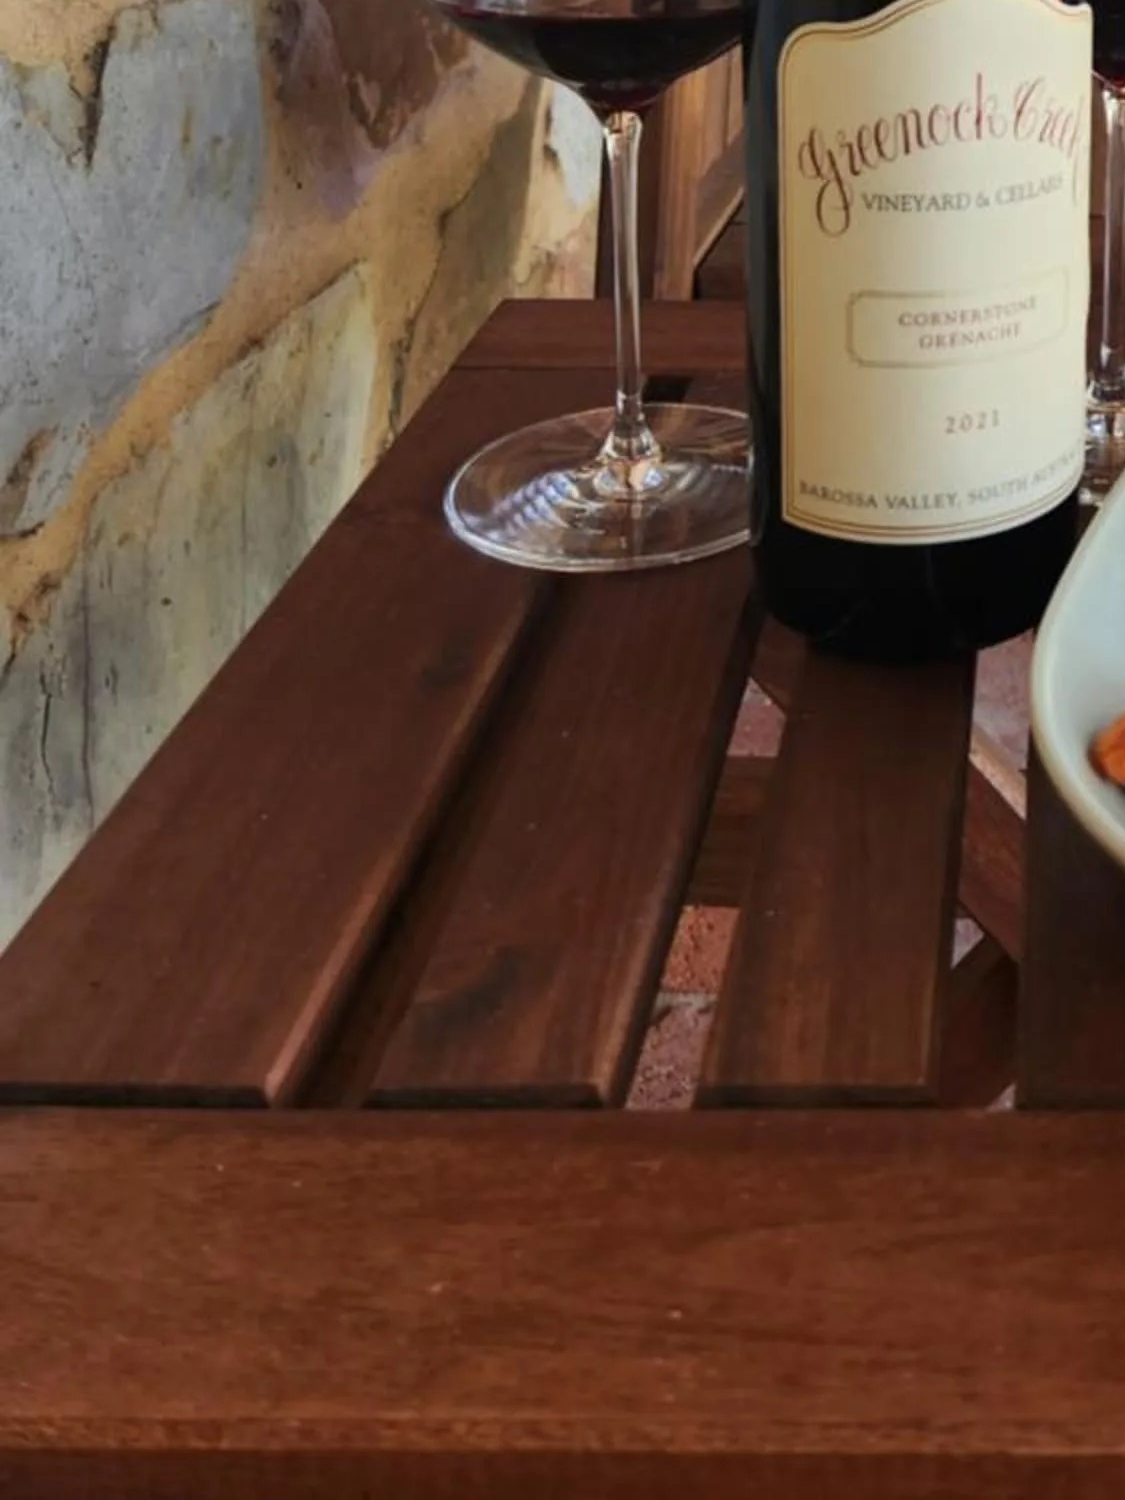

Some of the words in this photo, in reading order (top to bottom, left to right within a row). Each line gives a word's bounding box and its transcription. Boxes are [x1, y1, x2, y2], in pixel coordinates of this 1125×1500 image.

[797, 72, 1008, 238] Greenock
[860, 191, 971, 214] VINEYARD
[975, 192, 991, 209] &
[994, 171, 1064, 205] CELLARS
[897, 296, 1038, 328] CORNERSTONE
[918, 322, 1022, 350] GRENACHE
[944, 409, 1001, 435] 2021
[800, 480, 878, 510] BAROSSA
[886, 492, 963, 511] VALLEY,
[967, 477, 1028, 505] SOUTH
